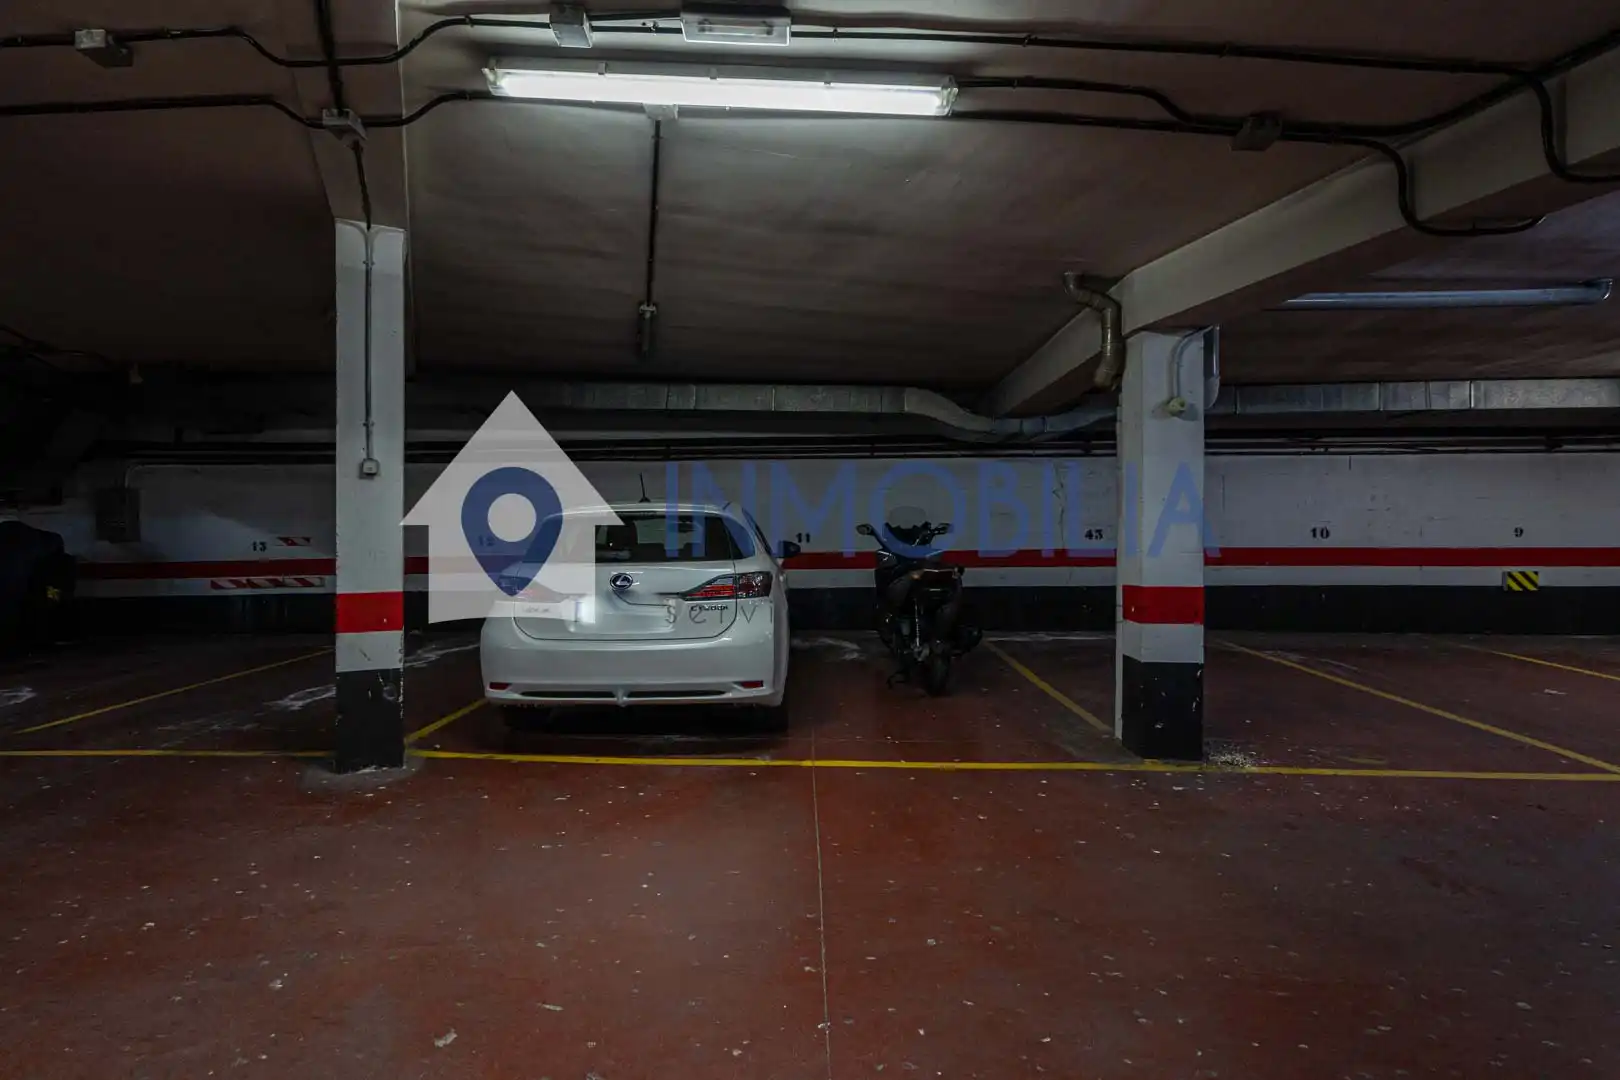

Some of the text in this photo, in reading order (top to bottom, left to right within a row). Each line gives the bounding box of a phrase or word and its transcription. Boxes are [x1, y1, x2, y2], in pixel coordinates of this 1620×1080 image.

[796, 532, 811, 543] 11
[1310, 526, 1331, 539] 10
[1513, 526, 1524, 538] 9
[252, 541, 267, 552] 13
